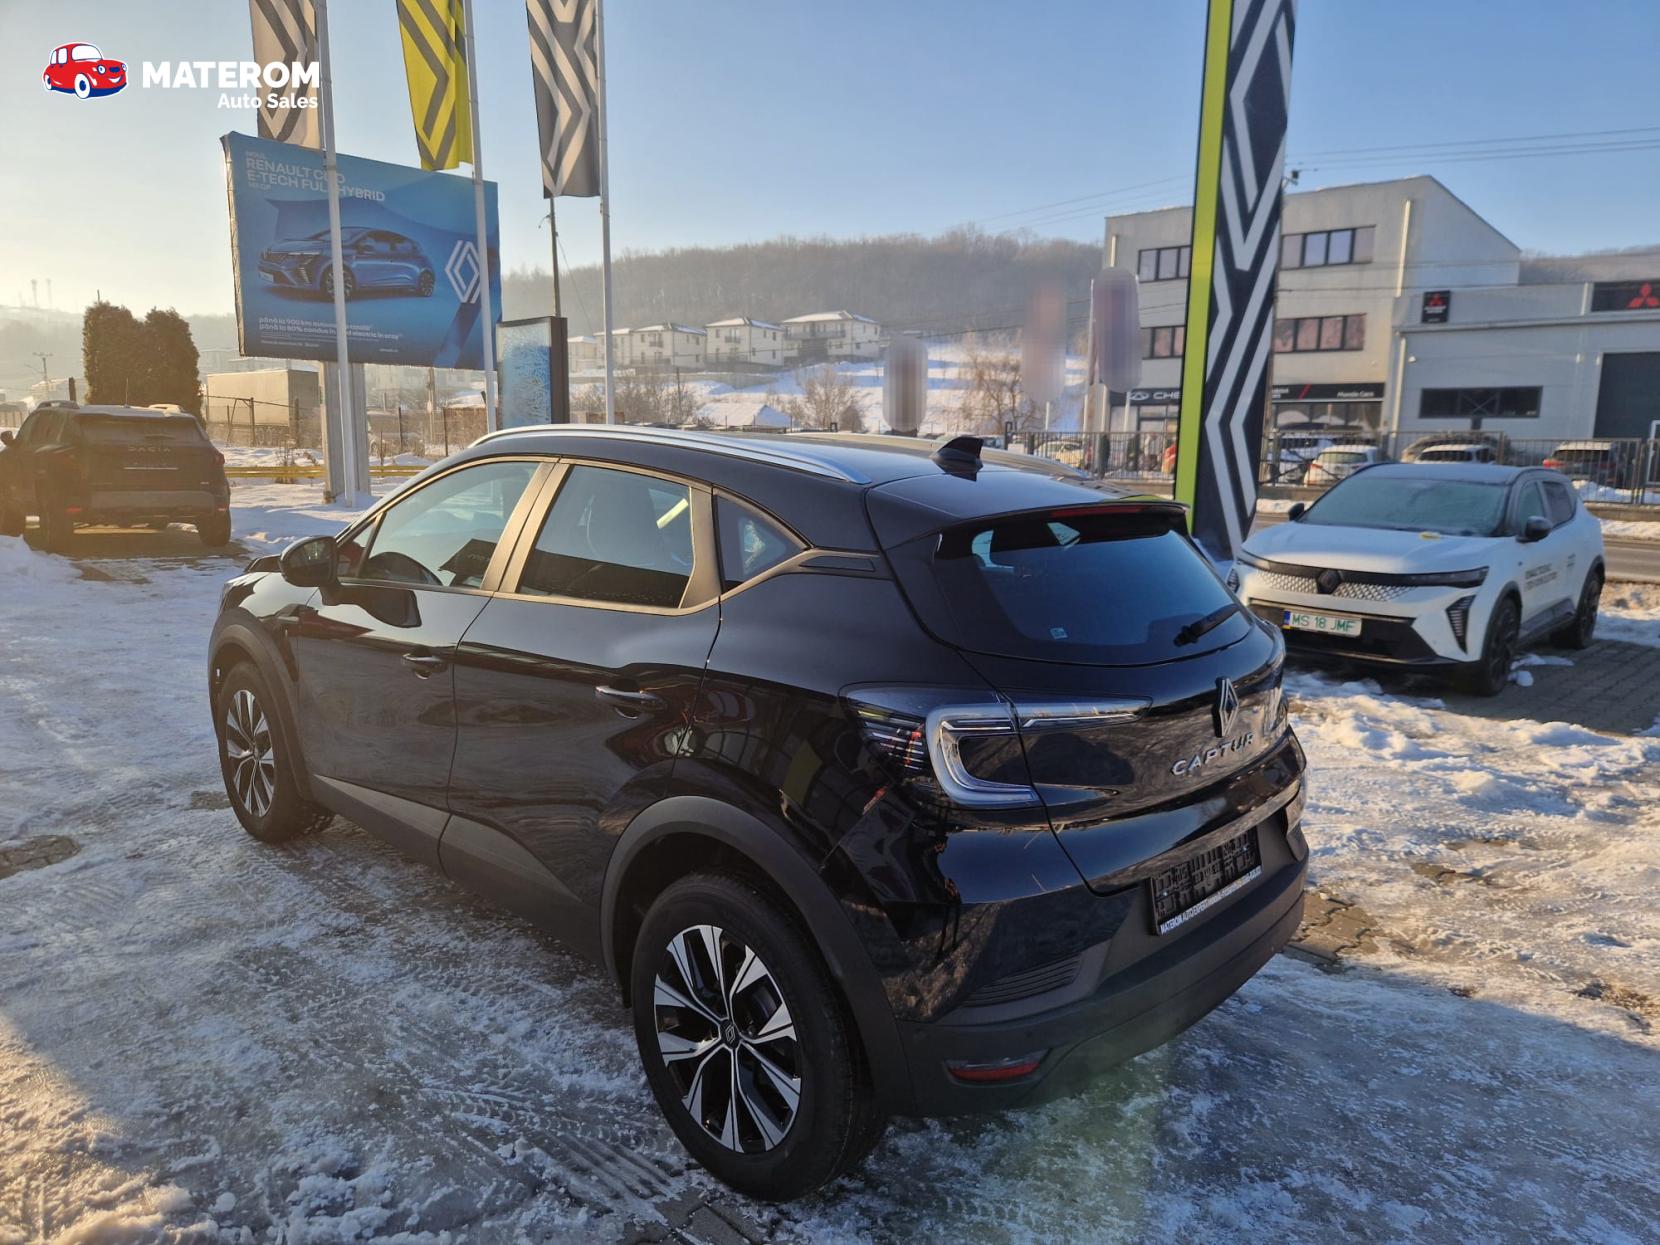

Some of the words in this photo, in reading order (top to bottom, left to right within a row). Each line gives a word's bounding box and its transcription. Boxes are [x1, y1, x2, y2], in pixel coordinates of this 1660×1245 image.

[246, 158, 312, 178] RENAULT
[313, 169, 346, 184] CLO
[247, 170, 298, 188] E-TECH
[302, 179, 329, 193] FUL
[338, 185, 386, 202] HYBRID
[1153, 391, 1181, 400] CHE
[1292, 614, 1310, 627] MS
[1315, 616, 1327, 629] 18
[1170, 731, 1254, 776] CAPTUR
